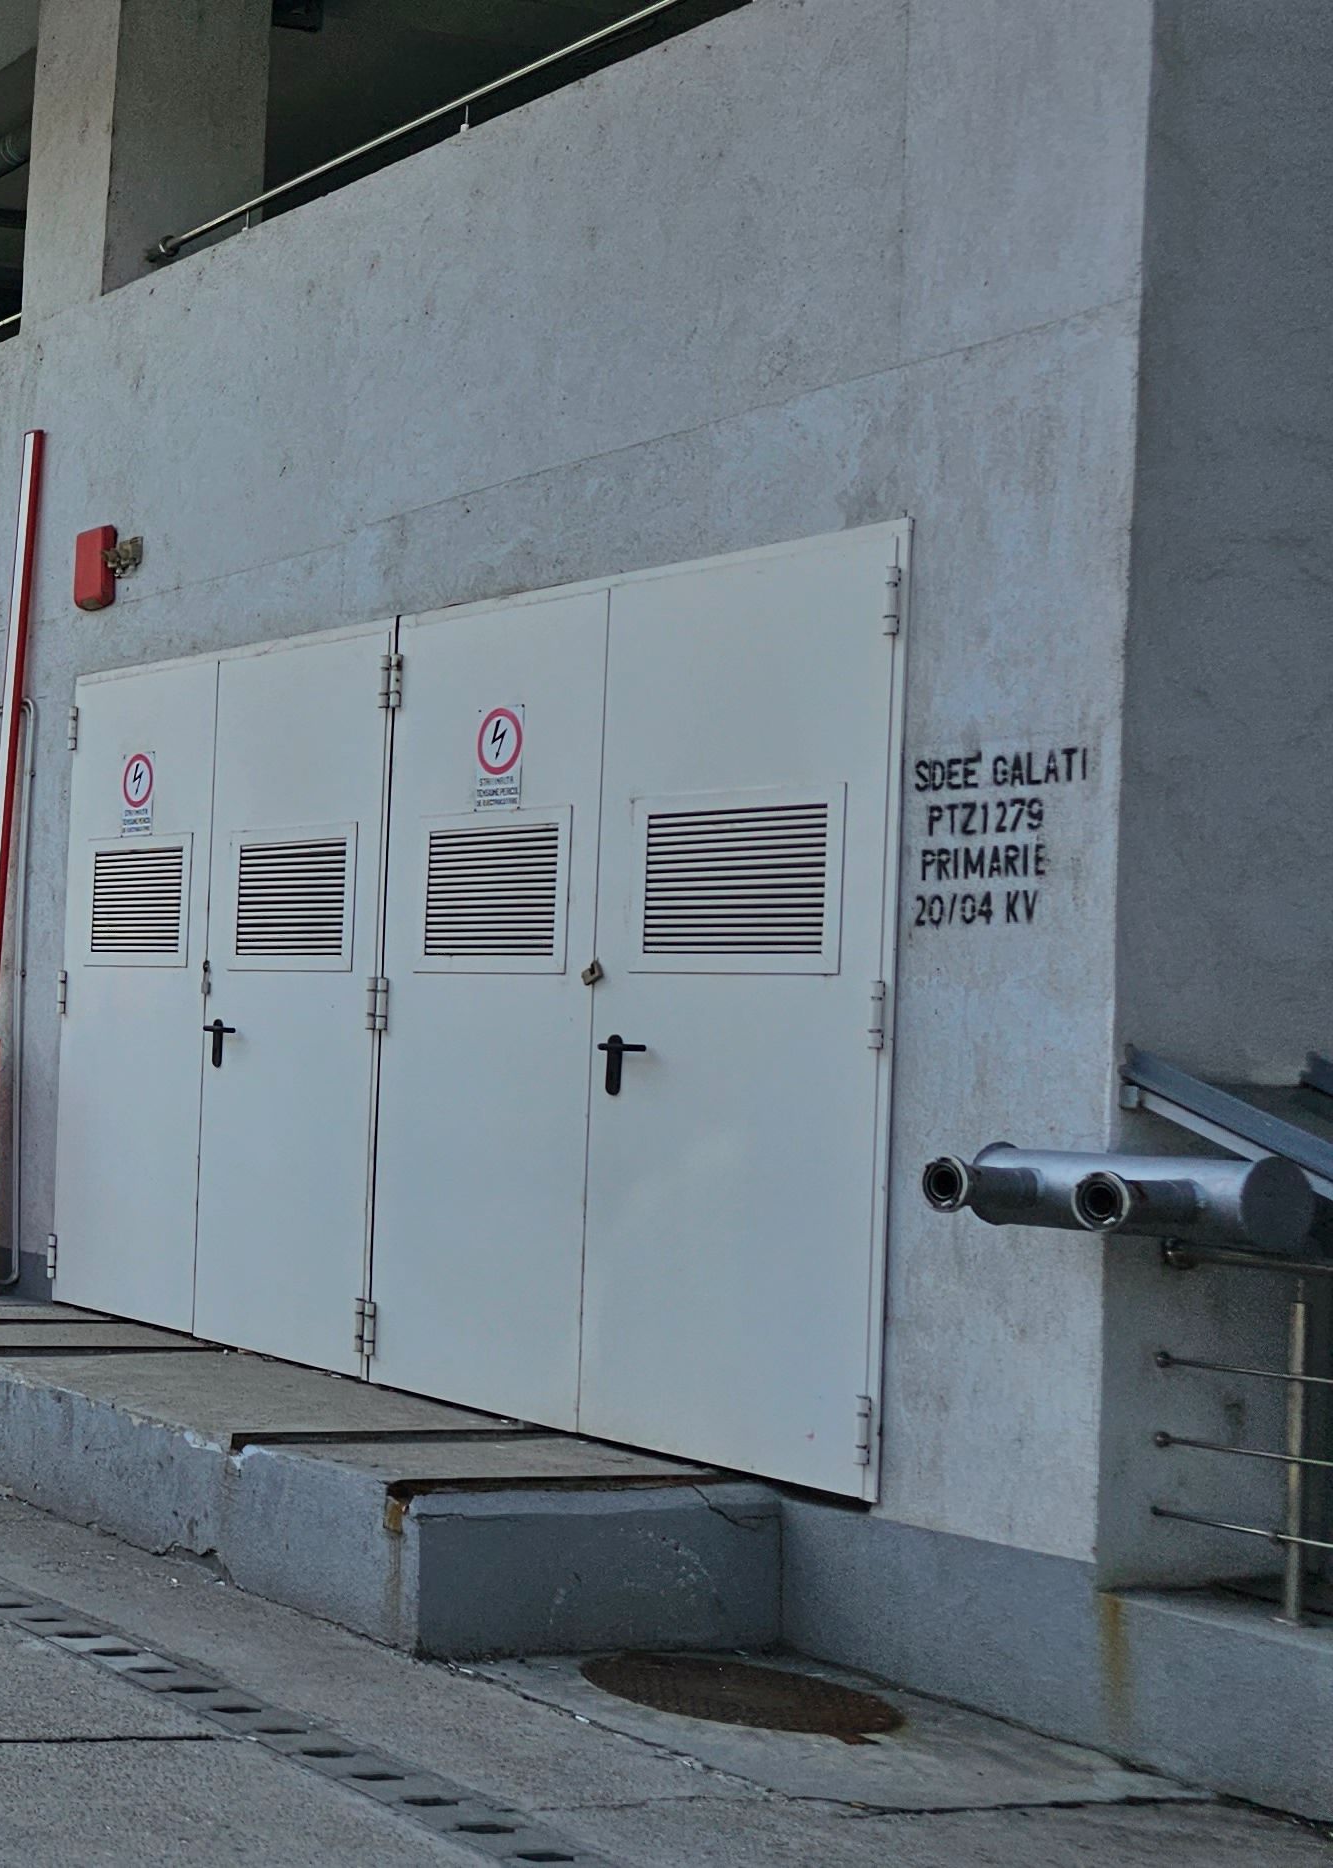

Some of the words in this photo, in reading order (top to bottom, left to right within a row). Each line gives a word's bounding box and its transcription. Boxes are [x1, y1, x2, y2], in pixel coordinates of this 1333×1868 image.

[915, 753, 982, 792] SDEE
[993, 747, 1087, 787] GALATI
[921, 844, 1046, 881] PRIMARIE
[915, 891, 993, 926] 20/04
[1006, 890, 1038, 923] KV
